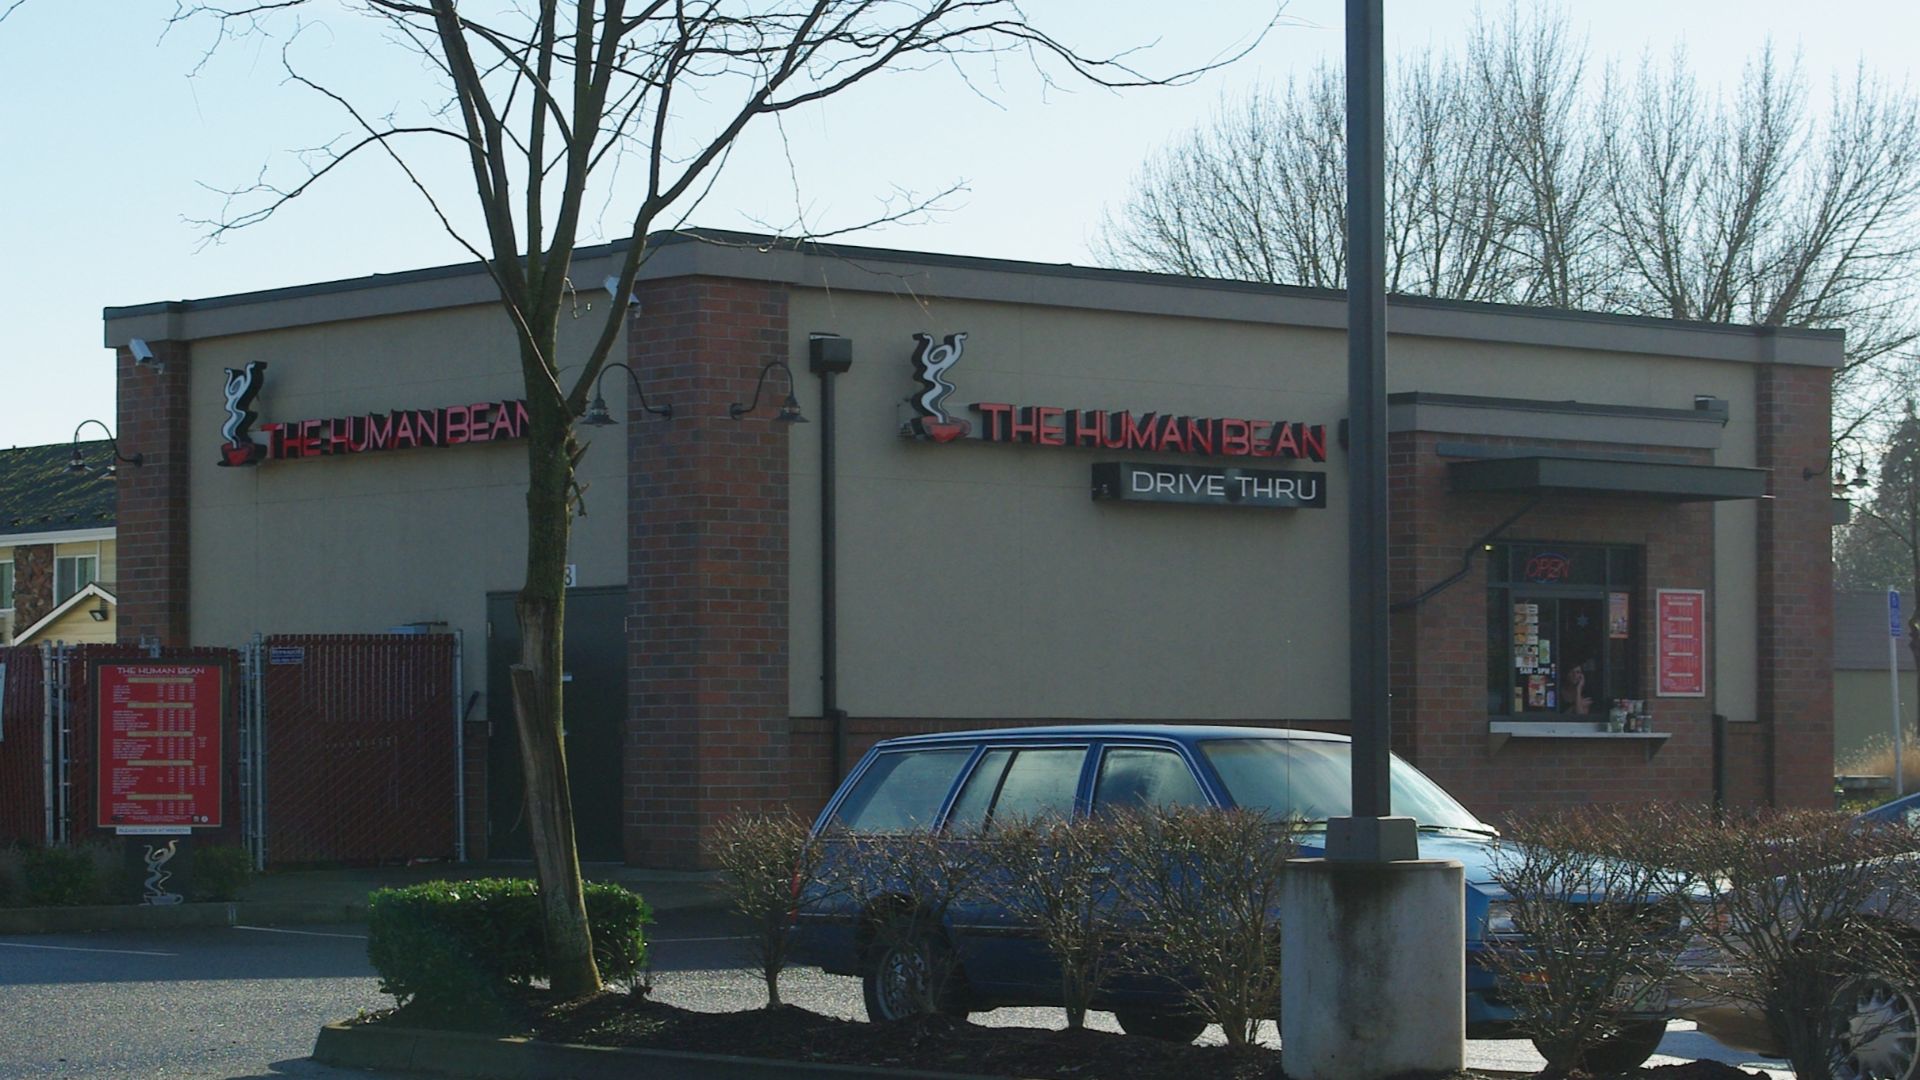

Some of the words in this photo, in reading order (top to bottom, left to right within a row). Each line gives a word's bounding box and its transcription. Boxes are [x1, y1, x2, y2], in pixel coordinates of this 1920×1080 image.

[260, 419, 322, 460] THE
[328, 408, 442, 455] HUMAN
[973, 402, 1065, 446] THE
[1070, 409, 1213, 456] HUMAN
[1219, 416, 1327, 462] BEAN
[1131, 470, 1226, 497] DRIVE
[1234, 475, 1317, 501] THRU
[1526, 557, 1570, 579] OPEN
[117, 667, 136, 675] THE
[138, 667, 176, 675] HUMAN
[177, 667, 205, 675] BEAN
